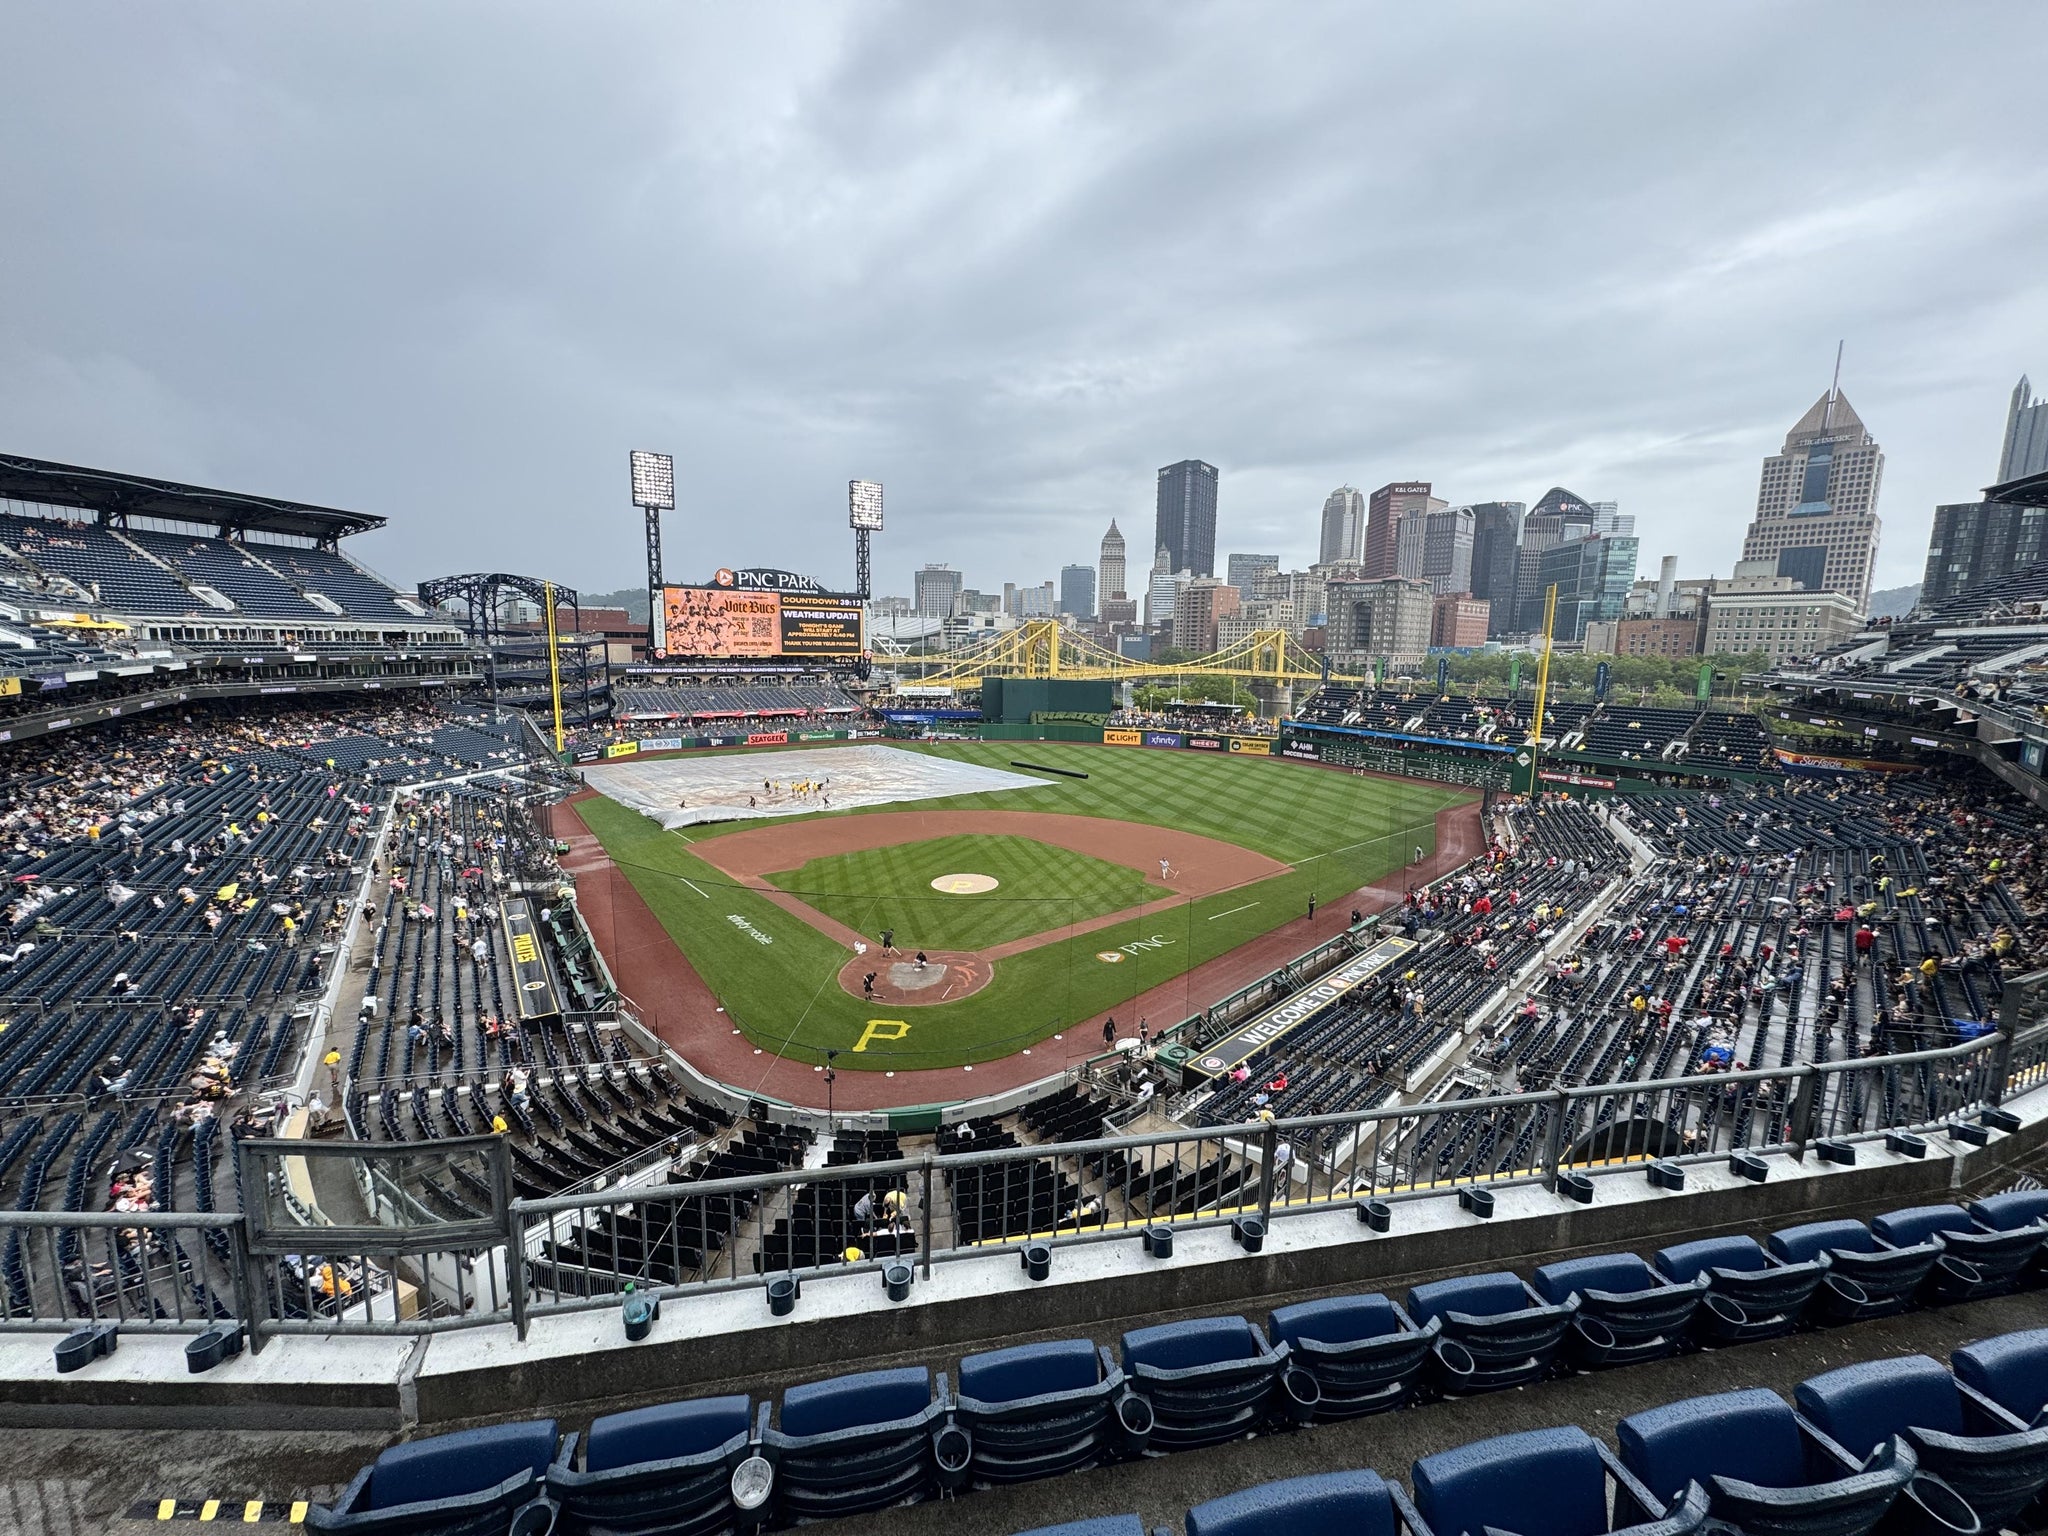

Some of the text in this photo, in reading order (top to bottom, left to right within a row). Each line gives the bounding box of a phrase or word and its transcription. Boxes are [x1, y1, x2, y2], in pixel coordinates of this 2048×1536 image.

[737, 571, 819, 589] PNC PARK
[782, 596, 839, 605] COUNTDOWN
[723, 599, 776, 614] Vote Bucs
[783, 610, 858, 620] WEATHER UPDATE
[1036, 710, 1108, 726] PIRATES
[710, 738, 723, 746] Lite
[750, 734, 785, 743] SEATGEEK
[1151, 736, 1176, 746] xfinity
[1298, 742, 1313, 751] AHN
[1283, 750, 1303, 758] SOCCER
[1800, 755, 1842, 768] Surfside
[1117, 934, 1176, 955] PNC
[1238, 952, 1390, 1045] WELCOME TO PNC PARK
[852, 1019, 912, 1052] P
